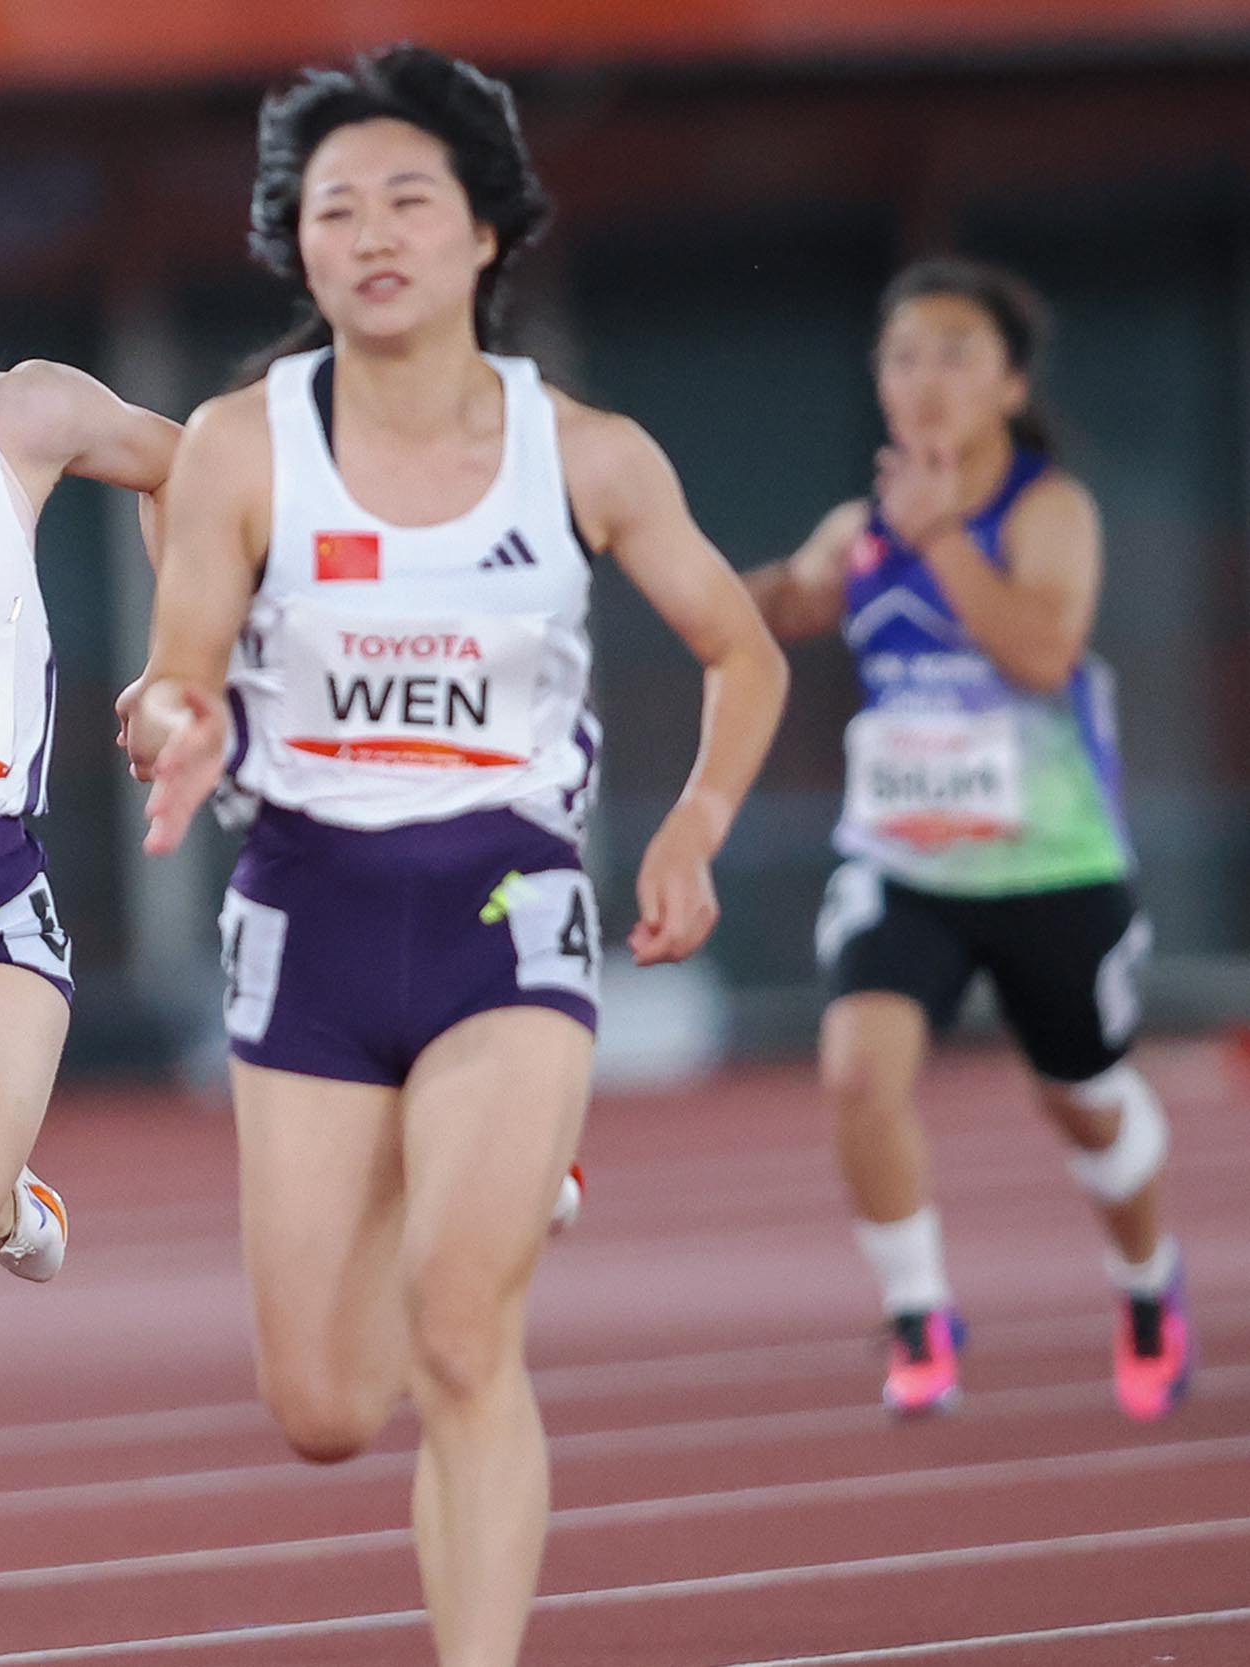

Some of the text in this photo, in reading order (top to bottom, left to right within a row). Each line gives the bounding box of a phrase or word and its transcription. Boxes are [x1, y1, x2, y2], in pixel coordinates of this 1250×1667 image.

[339, 630, 482, 661] TOYOTA
[326, 672, 490, 727] WEN
[559, 885, 592, 977] 4
